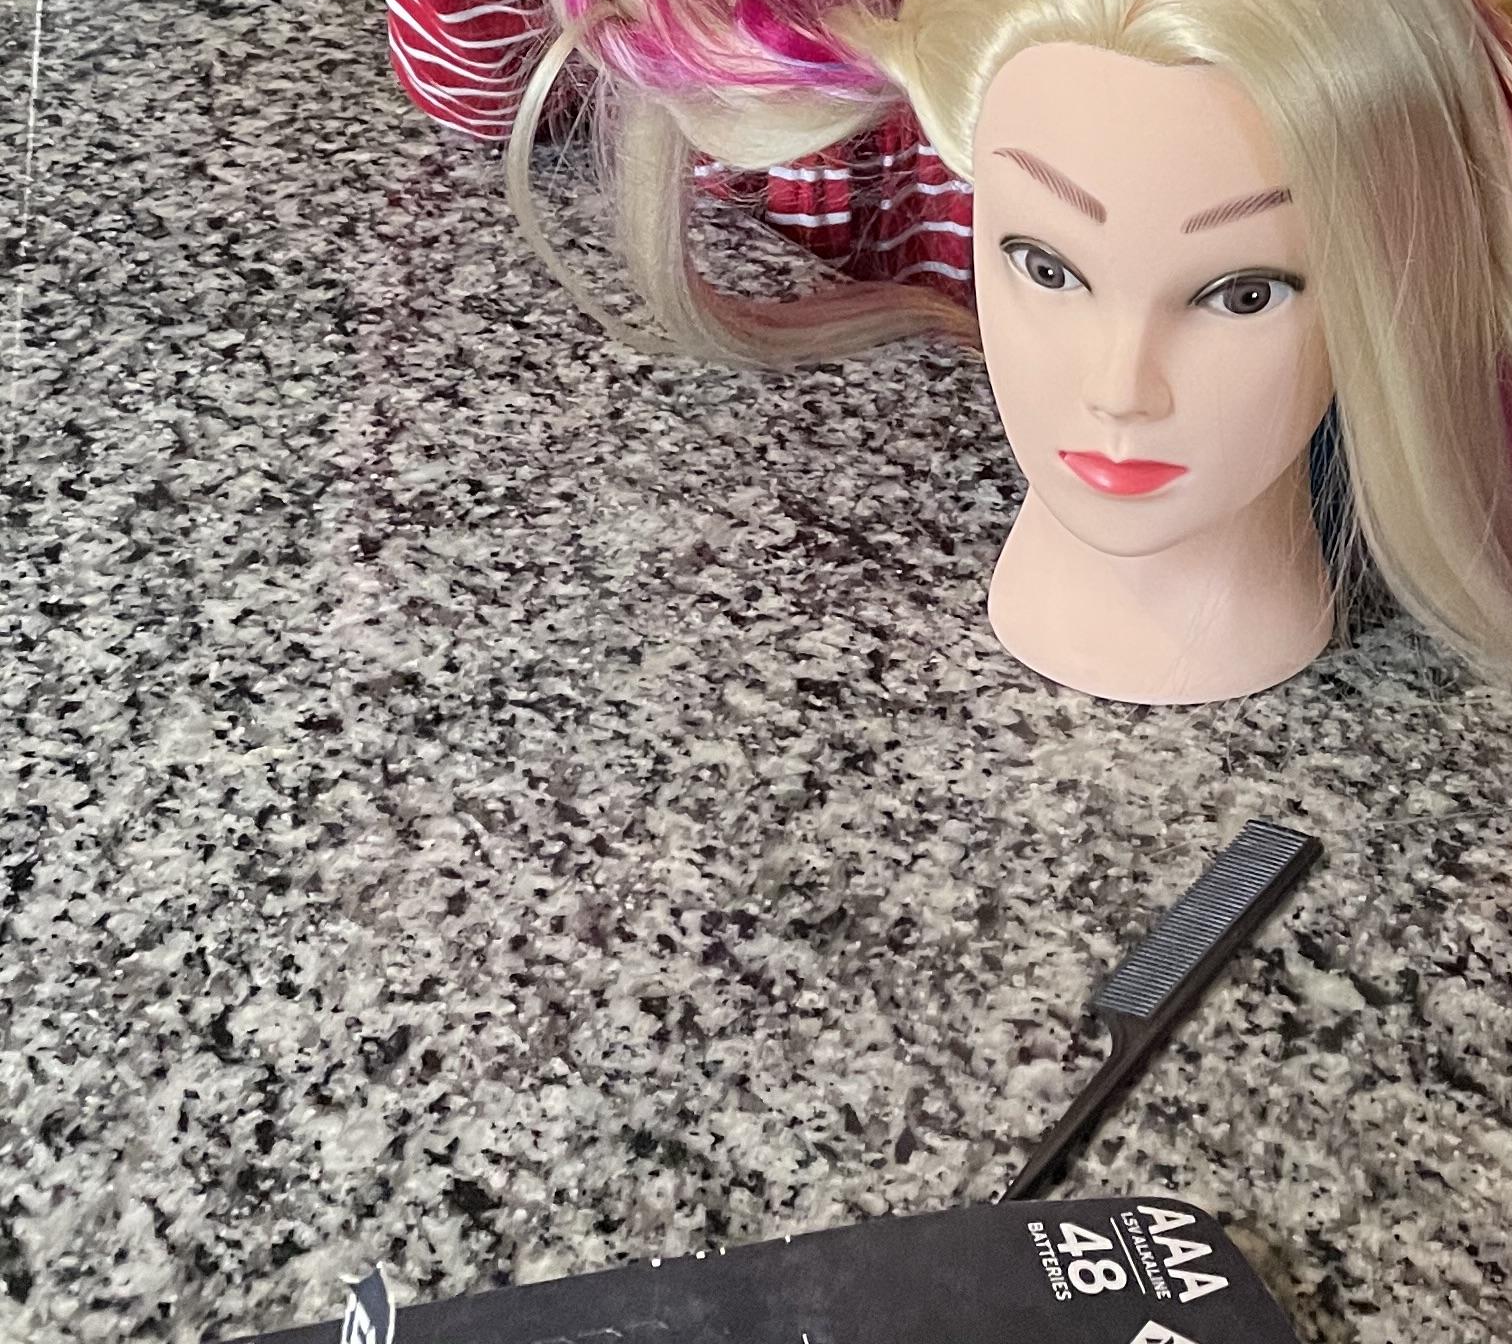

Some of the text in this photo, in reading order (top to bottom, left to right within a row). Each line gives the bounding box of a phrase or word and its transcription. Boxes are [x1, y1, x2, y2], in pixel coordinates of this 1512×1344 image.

[1027, 1221, 1072, 1302] BATTERIES
[1057, 1222, 1127, 1295] 48
[1131, 1233, 1171, 1300] ALKALINE
[1137, 1205, 1229, 1303] AAA
